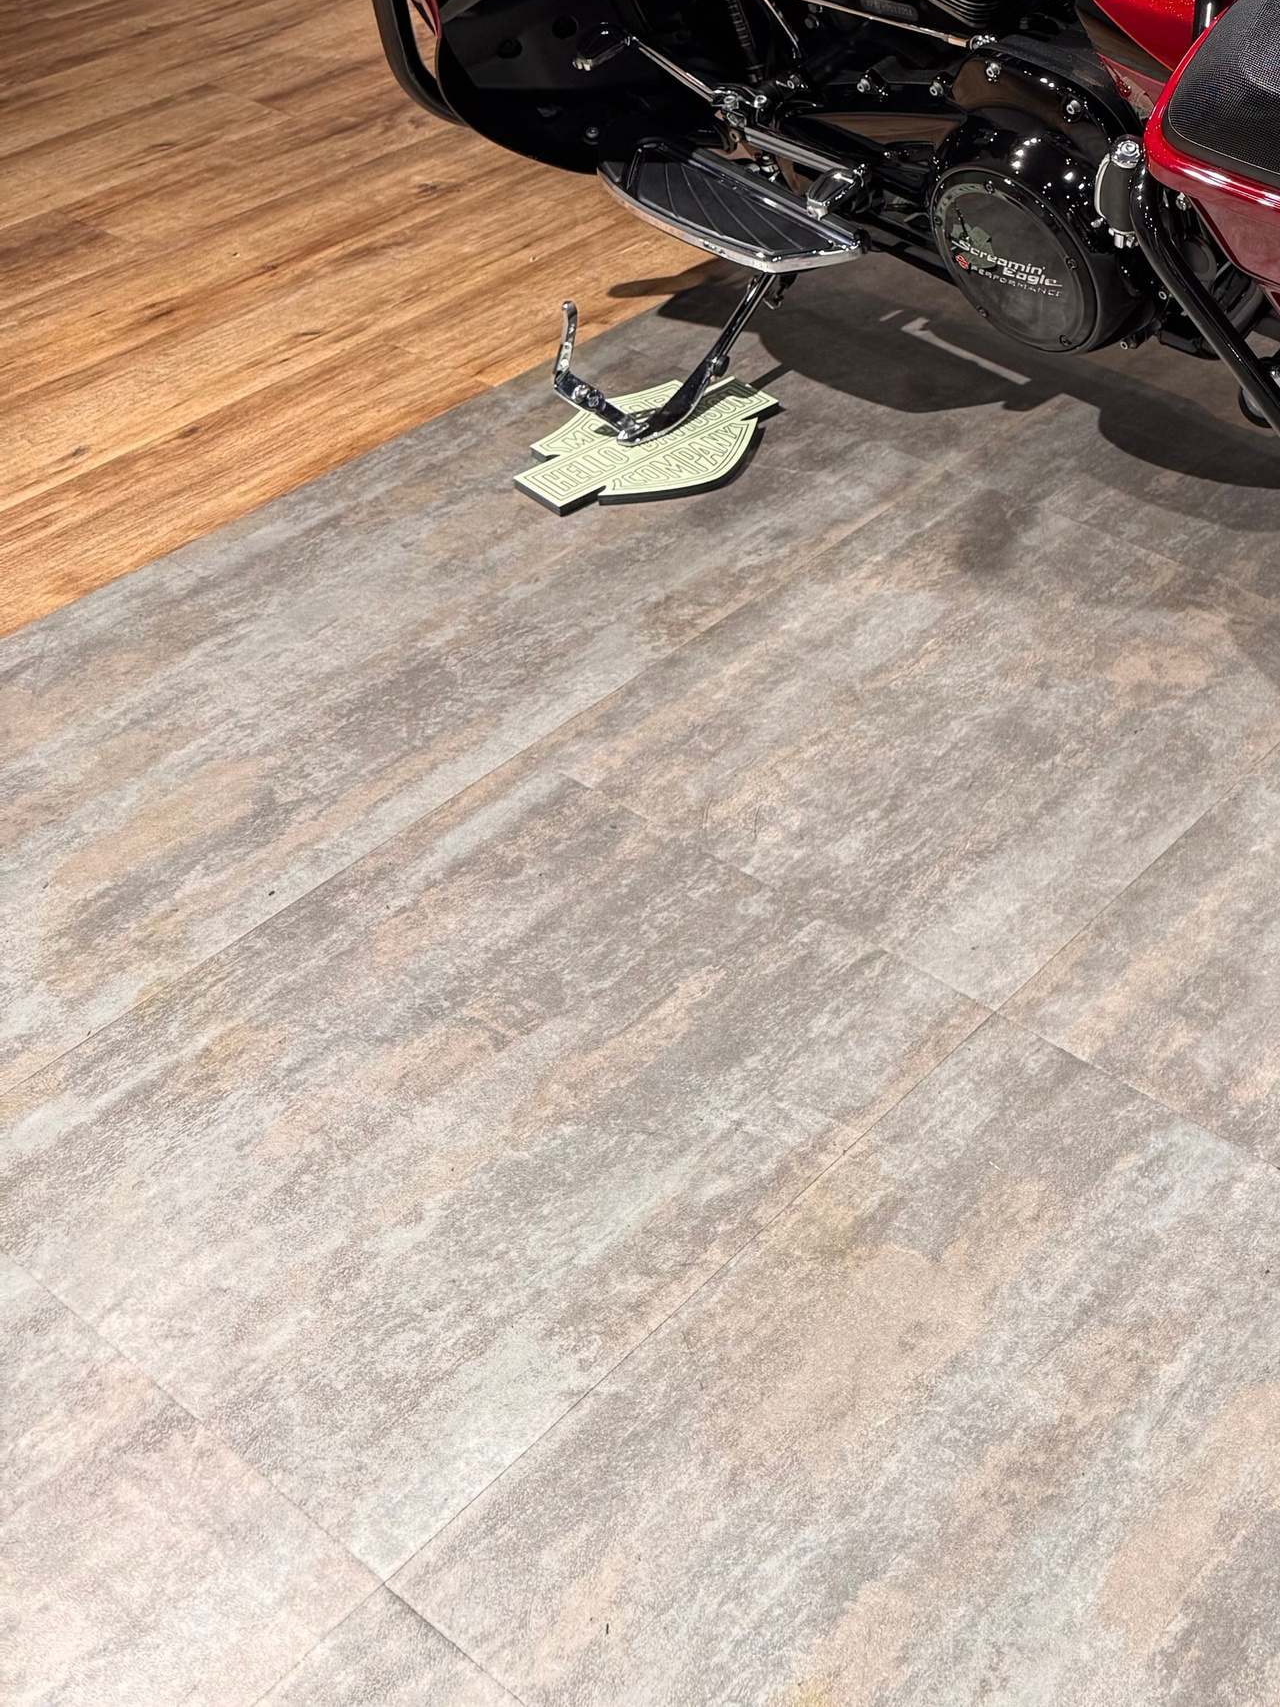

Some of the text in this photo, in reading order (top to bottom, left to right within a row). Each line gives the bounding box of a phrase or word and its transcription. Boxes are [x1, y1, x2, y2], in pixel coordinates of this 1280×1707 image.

[951, 239, 1046, 275] Screamin'
[970, 264, 1064, 298] PERFORMANCE
[1002, 266, 1063, 288] Eagle
[541, 447, 630, 492] HELLO
[621, 424, 738, 485] COMPANY
